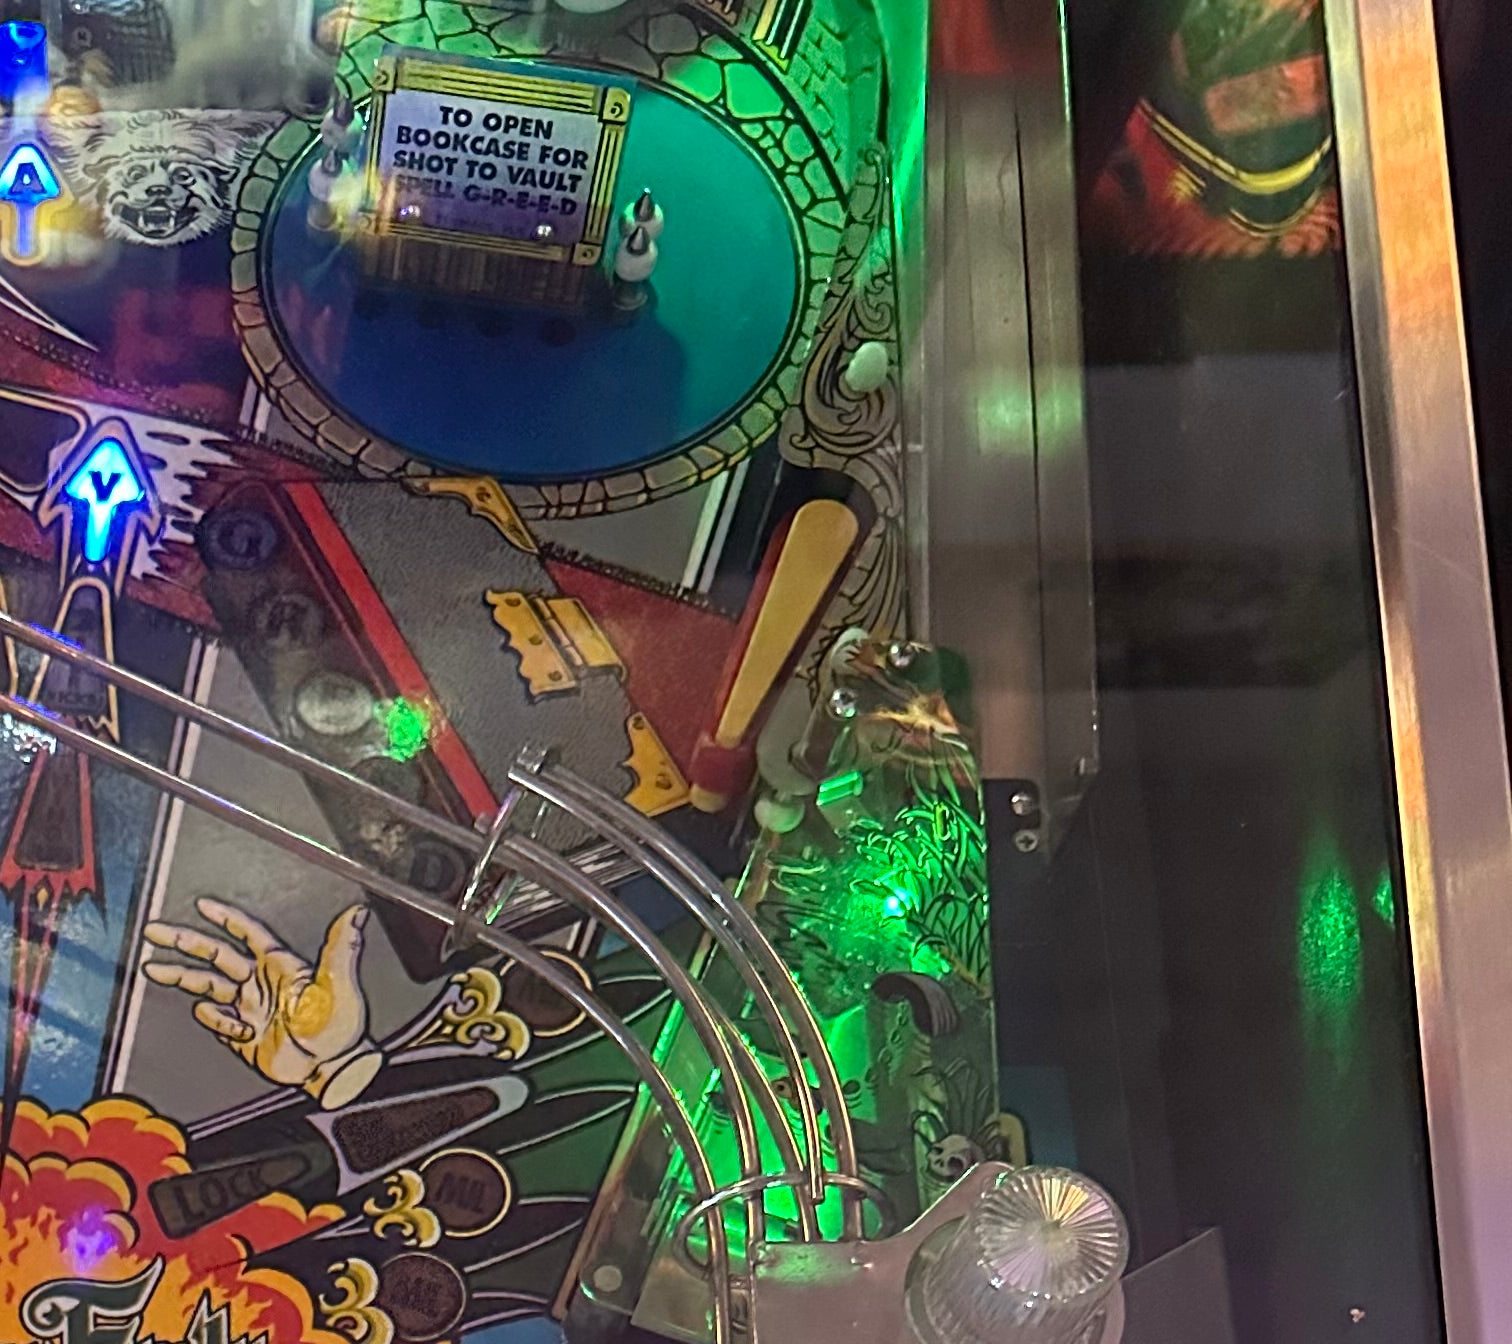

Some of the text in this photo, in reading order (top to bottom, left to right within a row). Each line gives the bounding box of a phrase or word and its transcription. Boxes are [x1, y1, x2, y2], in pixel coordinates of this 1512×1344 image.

[440, 106, 553, 139] TO OPEN
[397, 125, 589, 170] BOOKCASE FOR
[8, 162, 47, 194] A
[393, 150, 582, 193] SHOT TO VAULT
[396, 175, 577, 216] SPELL G-R-E-E-D
[89, 471, 121, 502] Y
[173, 1167, 263, 1224] LOCK
